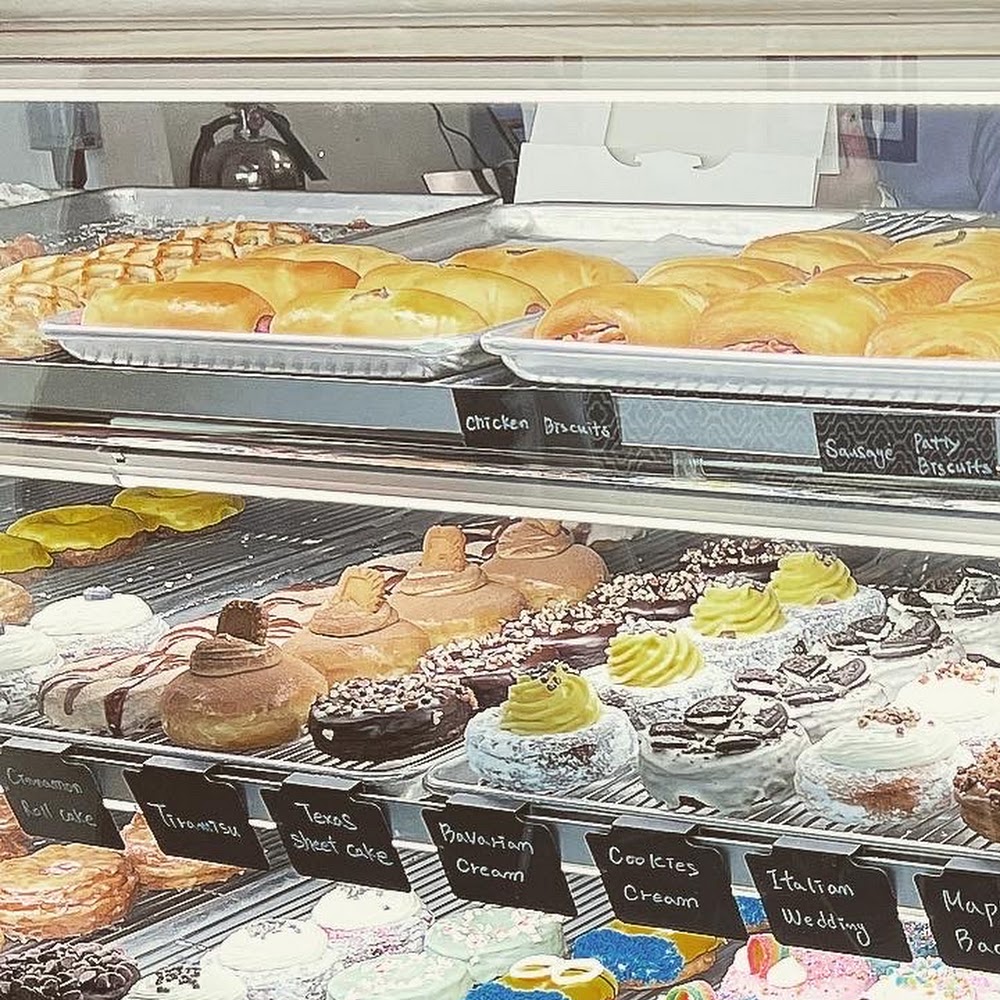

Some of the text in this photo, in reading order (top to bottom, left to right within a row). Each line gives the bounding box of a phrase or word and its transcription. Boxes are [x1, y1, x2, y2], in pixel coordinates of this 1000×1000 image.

[466, 413, 611, 438] Chicken Biscuits
[824, 432, 961, 468] Sausage Patty
[917, 457, 994, 477] Biscuits
[147, 802, 241, 838] Tiramisu
[294, 802, 358, 831] Texas
[438, 821, 534, 855] Bavarian
[456, 857, 525, 882] Cream
[608, 846, 699, 877] Cookies
[623, 885, 699, 908] Cream
[766, 869, 855, 897] Italian
[781, 907, 871, 947] Wedding
